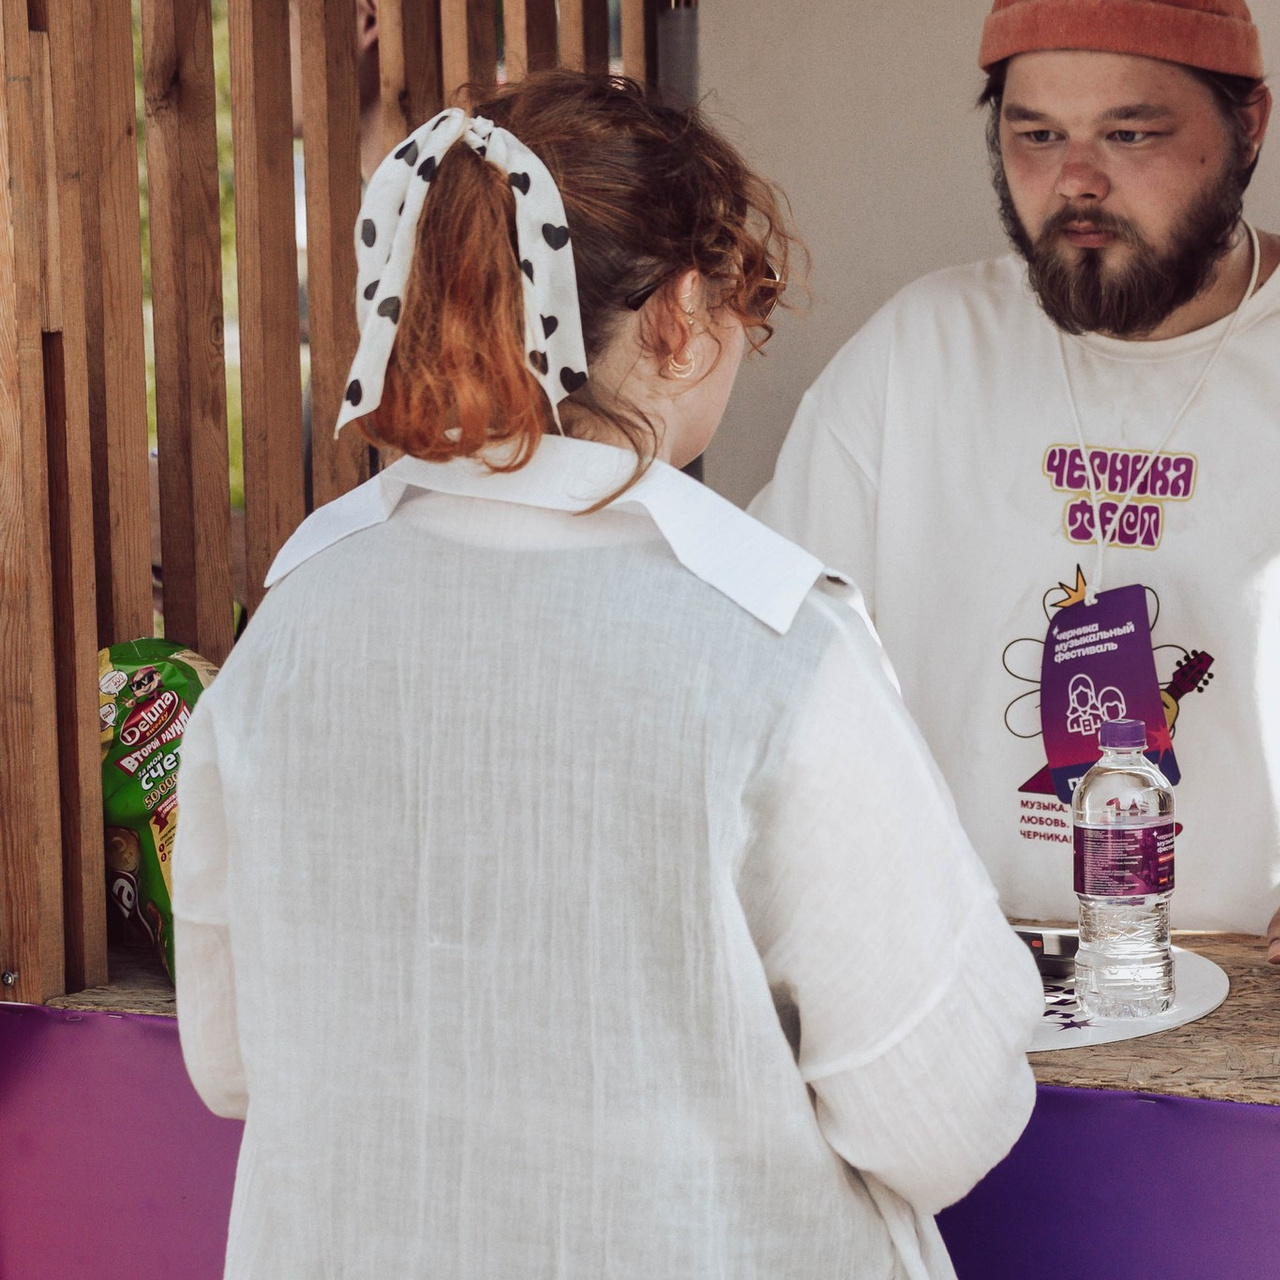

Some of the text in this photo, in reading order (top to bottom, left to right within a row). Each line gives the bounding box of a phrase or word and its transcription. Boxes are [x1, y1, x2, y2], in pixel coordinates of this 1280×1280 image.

[1046, 447, 1194, 497] ЧЕРНИКА
[1068, 499, 1160, 547] ФЕСТ
[1054, 621, 1135, 653] музыкальный
[1056, 622, 1099, 640] черника
[1053, 642, 1118, 664] фестиваль
[121, 691, 174, 745] Deluna
[119, 737, 161, 774] ВТОРОЙ
[1020, 799, 1069, 813] МУЗЫКА.
[1020, 814, 1070, 829] ЛЮБОВЬ.
